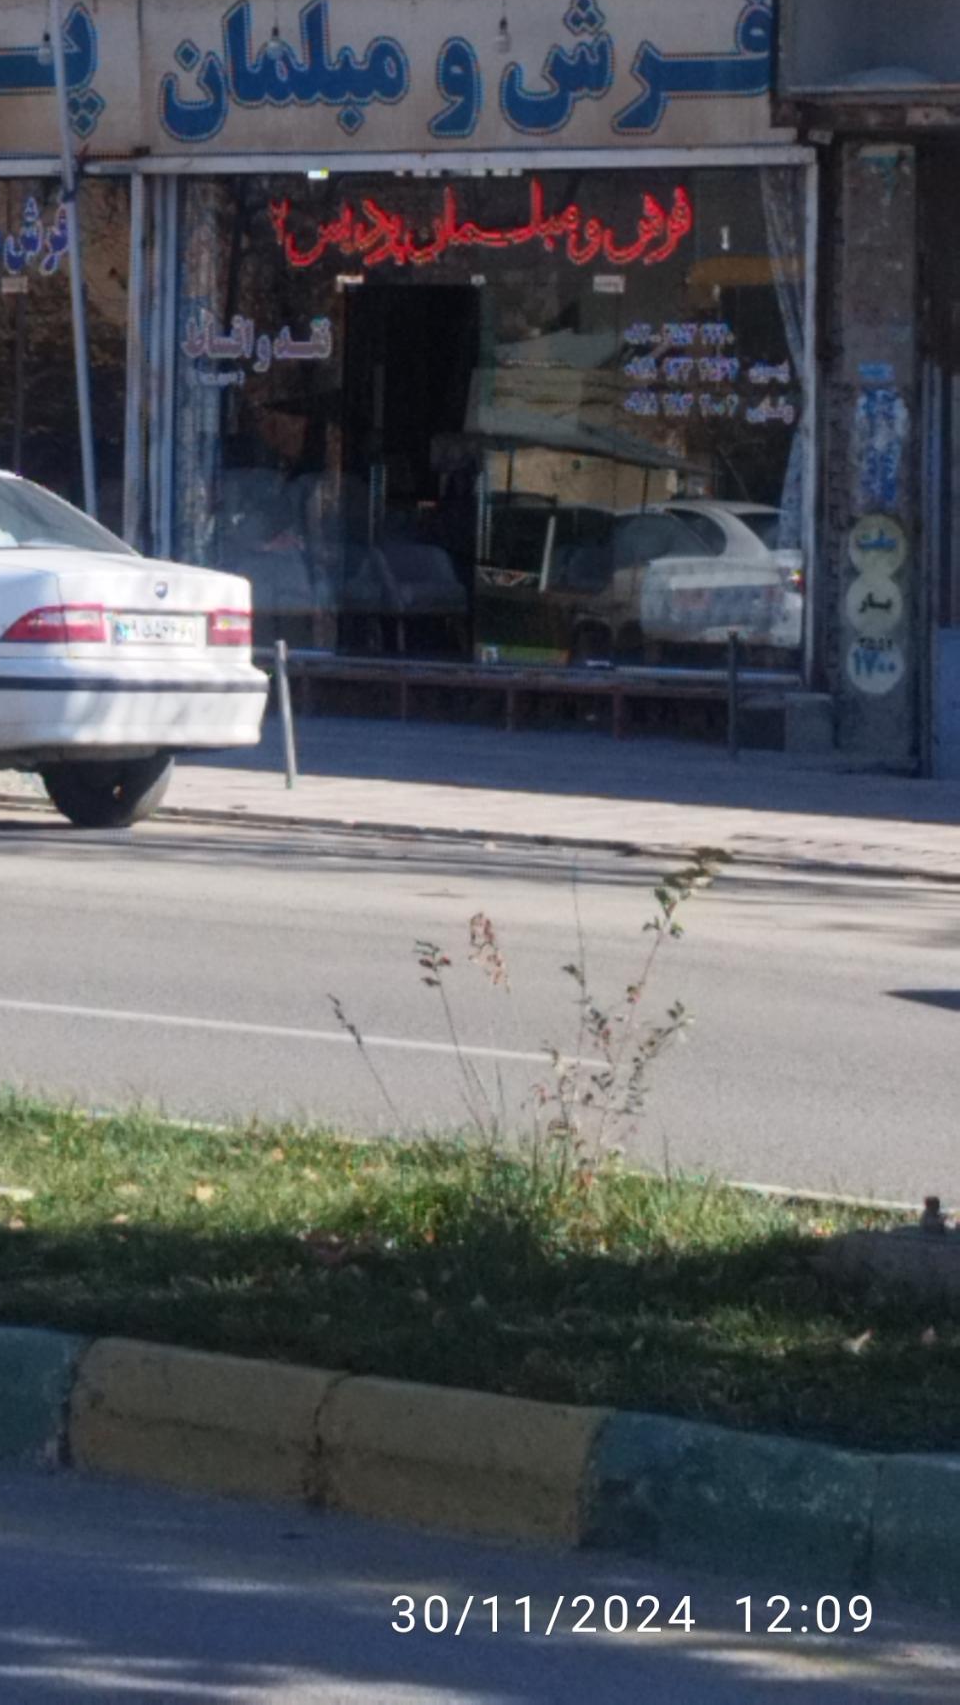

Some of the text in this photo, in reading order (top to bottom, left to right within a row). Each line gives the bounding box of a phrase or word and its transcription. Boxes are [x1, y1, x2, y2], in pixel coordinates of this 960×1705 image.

[429, 36, 483, 138] و
[566, 216, 603, 266] و
[252, 333, 272, 373] و
